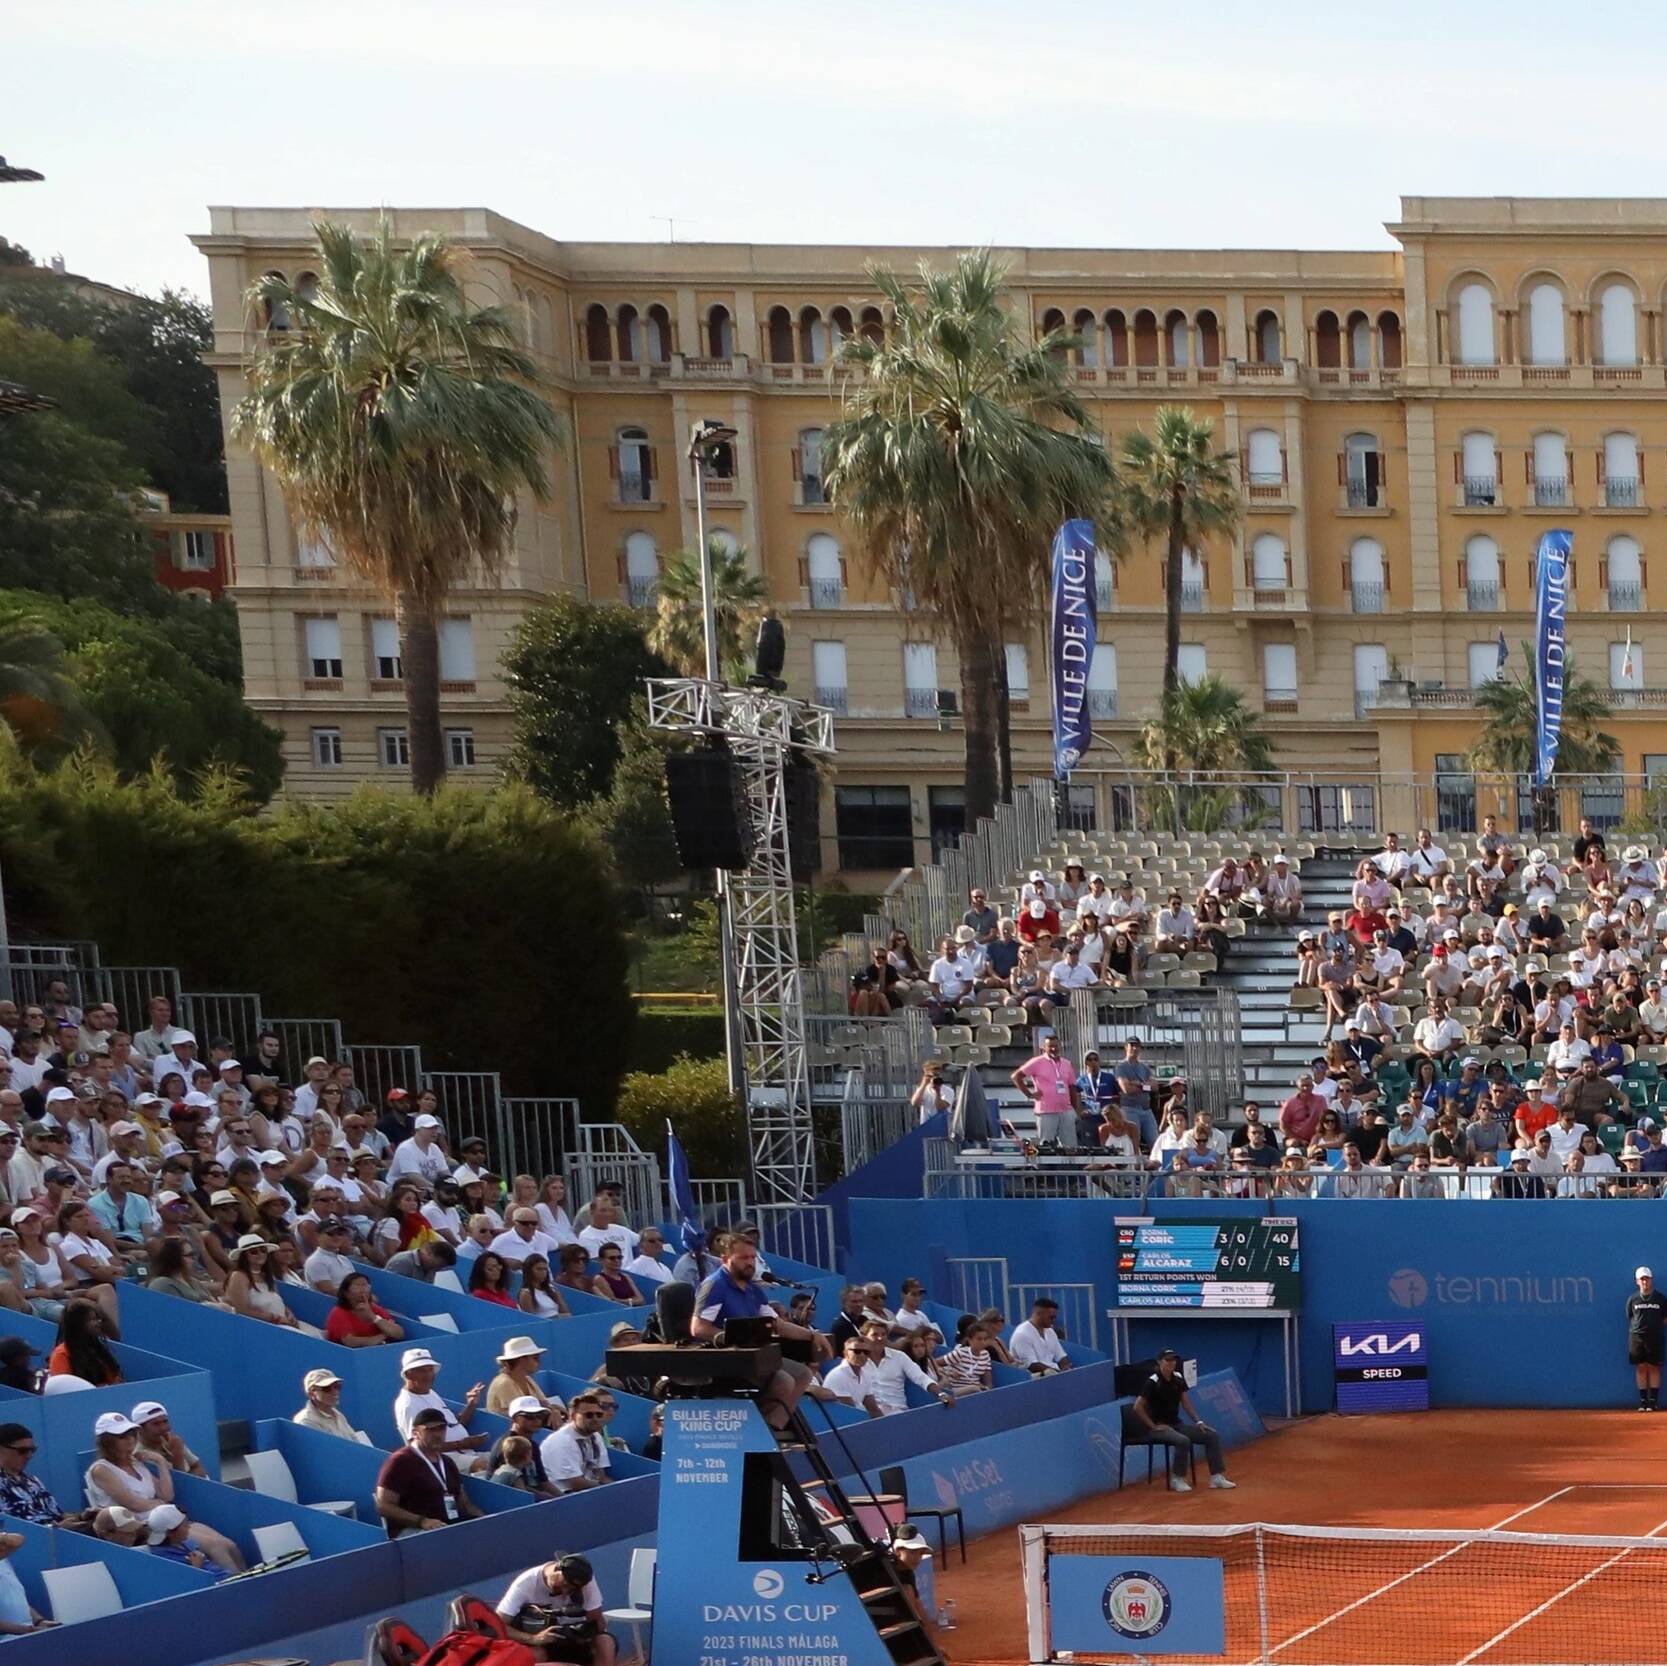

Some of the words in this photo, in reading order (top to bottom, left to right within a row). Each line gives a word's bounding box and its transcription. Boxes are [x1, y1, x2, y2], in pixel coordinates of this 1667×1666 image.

[1063, 548, 1087, 618] NICE
[1548, 547, 1569, 620] NICE
[1063, 624, 1087, 664] DE
[1548, 628, 1564, 666] DE
[1062, 670, 1085, 741] VILLE
[1545, 675, 1564, 750] VILLE
[1141, 1236, 1174, 1244] CORIC
[1219, 1233, 1228, 1244] 3
[1236, 1233, 1246, 1244] 0
[1272, 1233, 1289, 1244] 40
[1142, 1259, 1192, 1268] ALCARAZ
[1220, 1256, 1229, 1266] 6
[1237, 1256, 1247, 1266] 0
[1277, 1256, 1290, 1266] 15
[1434, 1272, 1594, 1303] tennium
[1340, 1333, 1420, 1356] KIA
[1362, 1367, 1402, 1380] SPEED
[672, 1410, 711, 1421] BILLIE
[713, 1410, 748, 1421] JEAN
[680, 1421, 712, 1431] KING
[714, 1421, 742, 1432] CUP
[677, 1458, 694, 1469] 7th
[704, 1458, 726, 1469] 12th
[676, 1473, 728, 1484] NOVEMBER
[704, 1605, 776, 1622] DAVIS
[784, 1604, 838, 1622] CUP
[704, 1636, 735, 1649] 2023
[739, 1636, 784, 1649] FINALS
[789, 1633, 839, 1649] MÁLAGA
